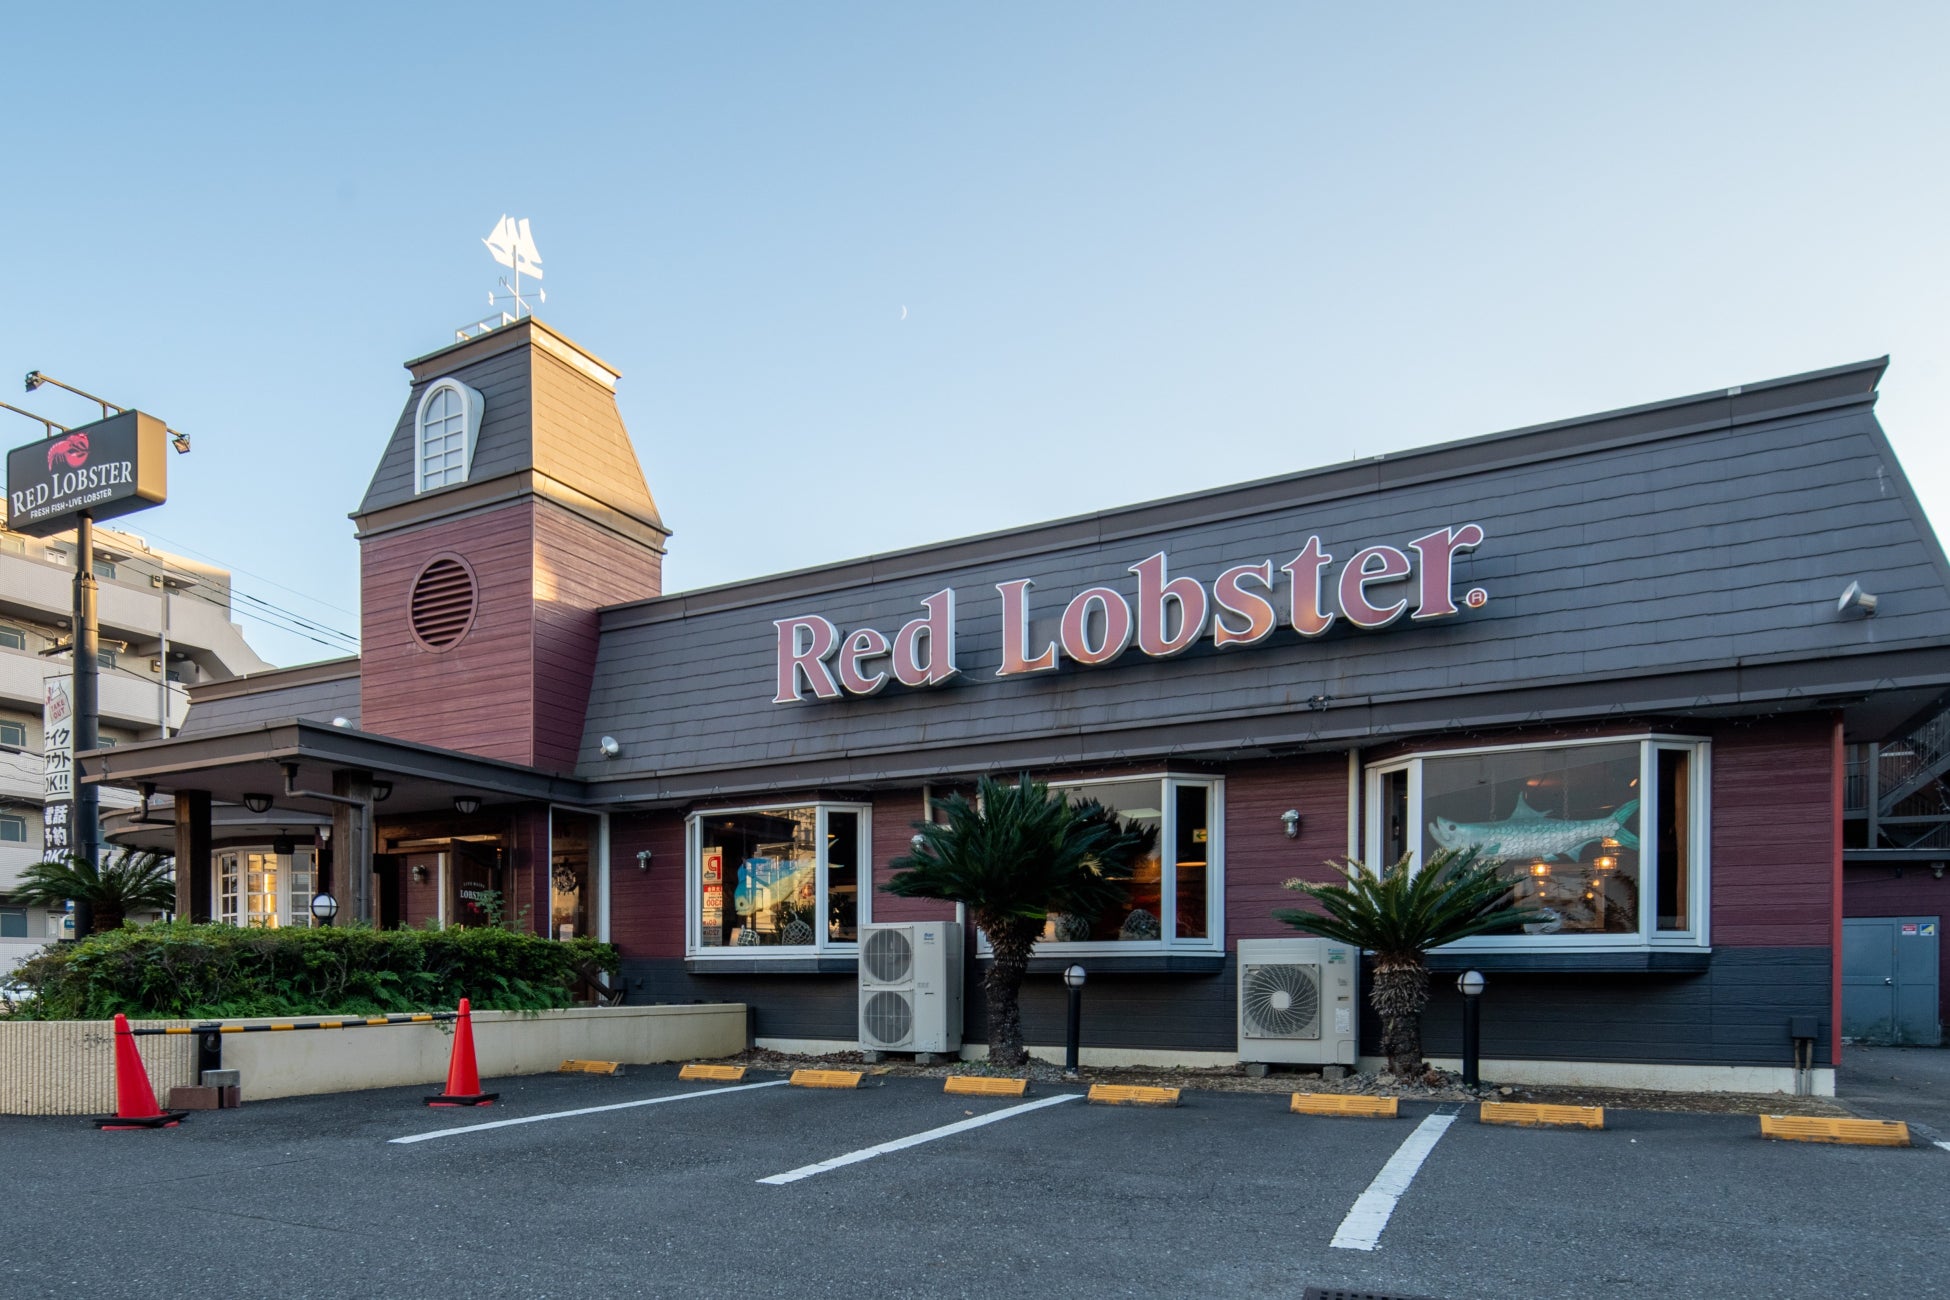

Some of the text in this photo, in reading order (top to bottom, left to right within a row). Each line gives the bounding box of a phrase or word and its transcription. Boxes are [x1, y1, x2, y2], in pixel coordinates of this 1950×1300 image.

[11, 461, 133, 517] RED LOBSTER
[30, 506, 50, 519] FRESH
[83, 488, 112, 504] LOBSTER
[771, 523, 1484, 703] Red Lobster
[50, 699, 65, 712] TAKE
[53, 707, 65, 720] OUT
[460, 890, 487, 900] LOBST
